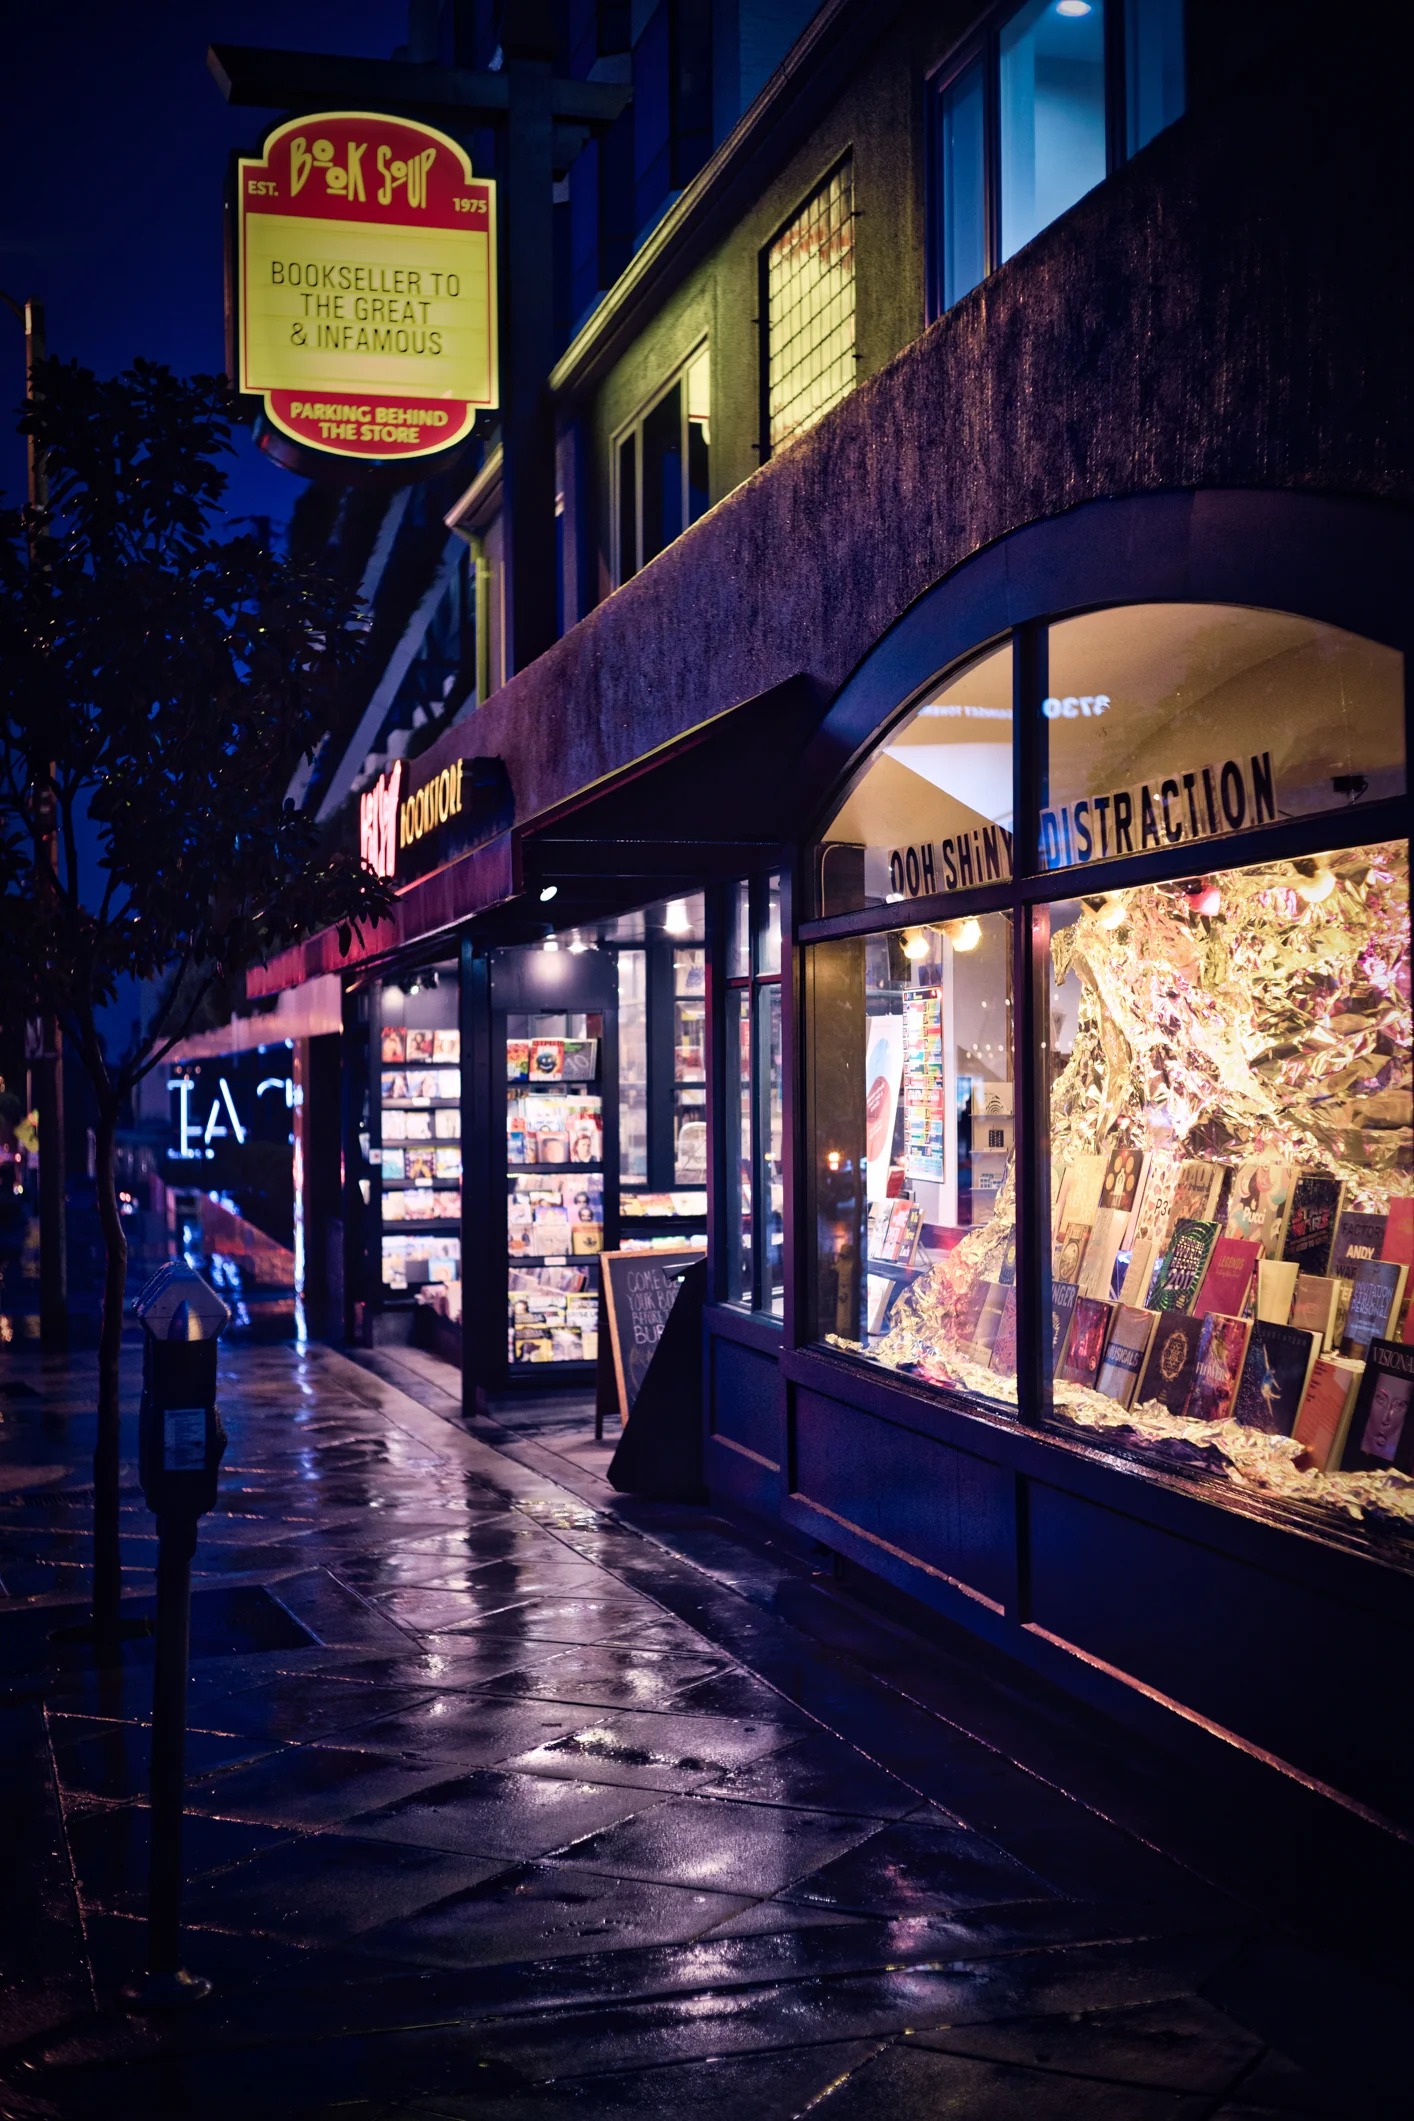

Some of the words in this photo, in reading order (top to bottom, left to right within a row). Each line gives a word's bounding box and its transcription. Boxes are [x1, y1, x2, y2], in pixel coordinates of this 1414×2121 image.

[290, 136, 367, 202] BOOK
[377, 145, 437, 209] SOUP
[248, 181, 279, 197] EST.
[452, 197, 487, 213] 1975
[272, 261, 421, 292] BOOKSELLER
[431, 273, 460, 296] TO
[300, 293, 345, 319] THE
[355, 298, 431, 324] GREAT
[290, 323, 308, 346] &
[317, 325, 443, 355] INFAMOUS
[290, 402, 371, 422] PARKING
[374, 408, 448, 426] BEHIND
[319, 421, 358, 440] THE
[360, 425, 420, 443] STORE
[890, 844, 936, 896] OOH
[1040, 752, 1276, 869] DISTRACTION
[1243, 1207, 1267, 1224] Pucci
[1346, 1245, 1375, 1260] ANDY
[627, 1270, 661, 1292] COME
[1163, 1269, 1197, 1290] 2017
[1356, 1281, 1394, 1298] INVITATION
[625, 1291, 655, 1311] YOUR
[1351, 1303, 1388, 1318] PERSONAL
[632, 1310, 663, 1325] BEFORE
